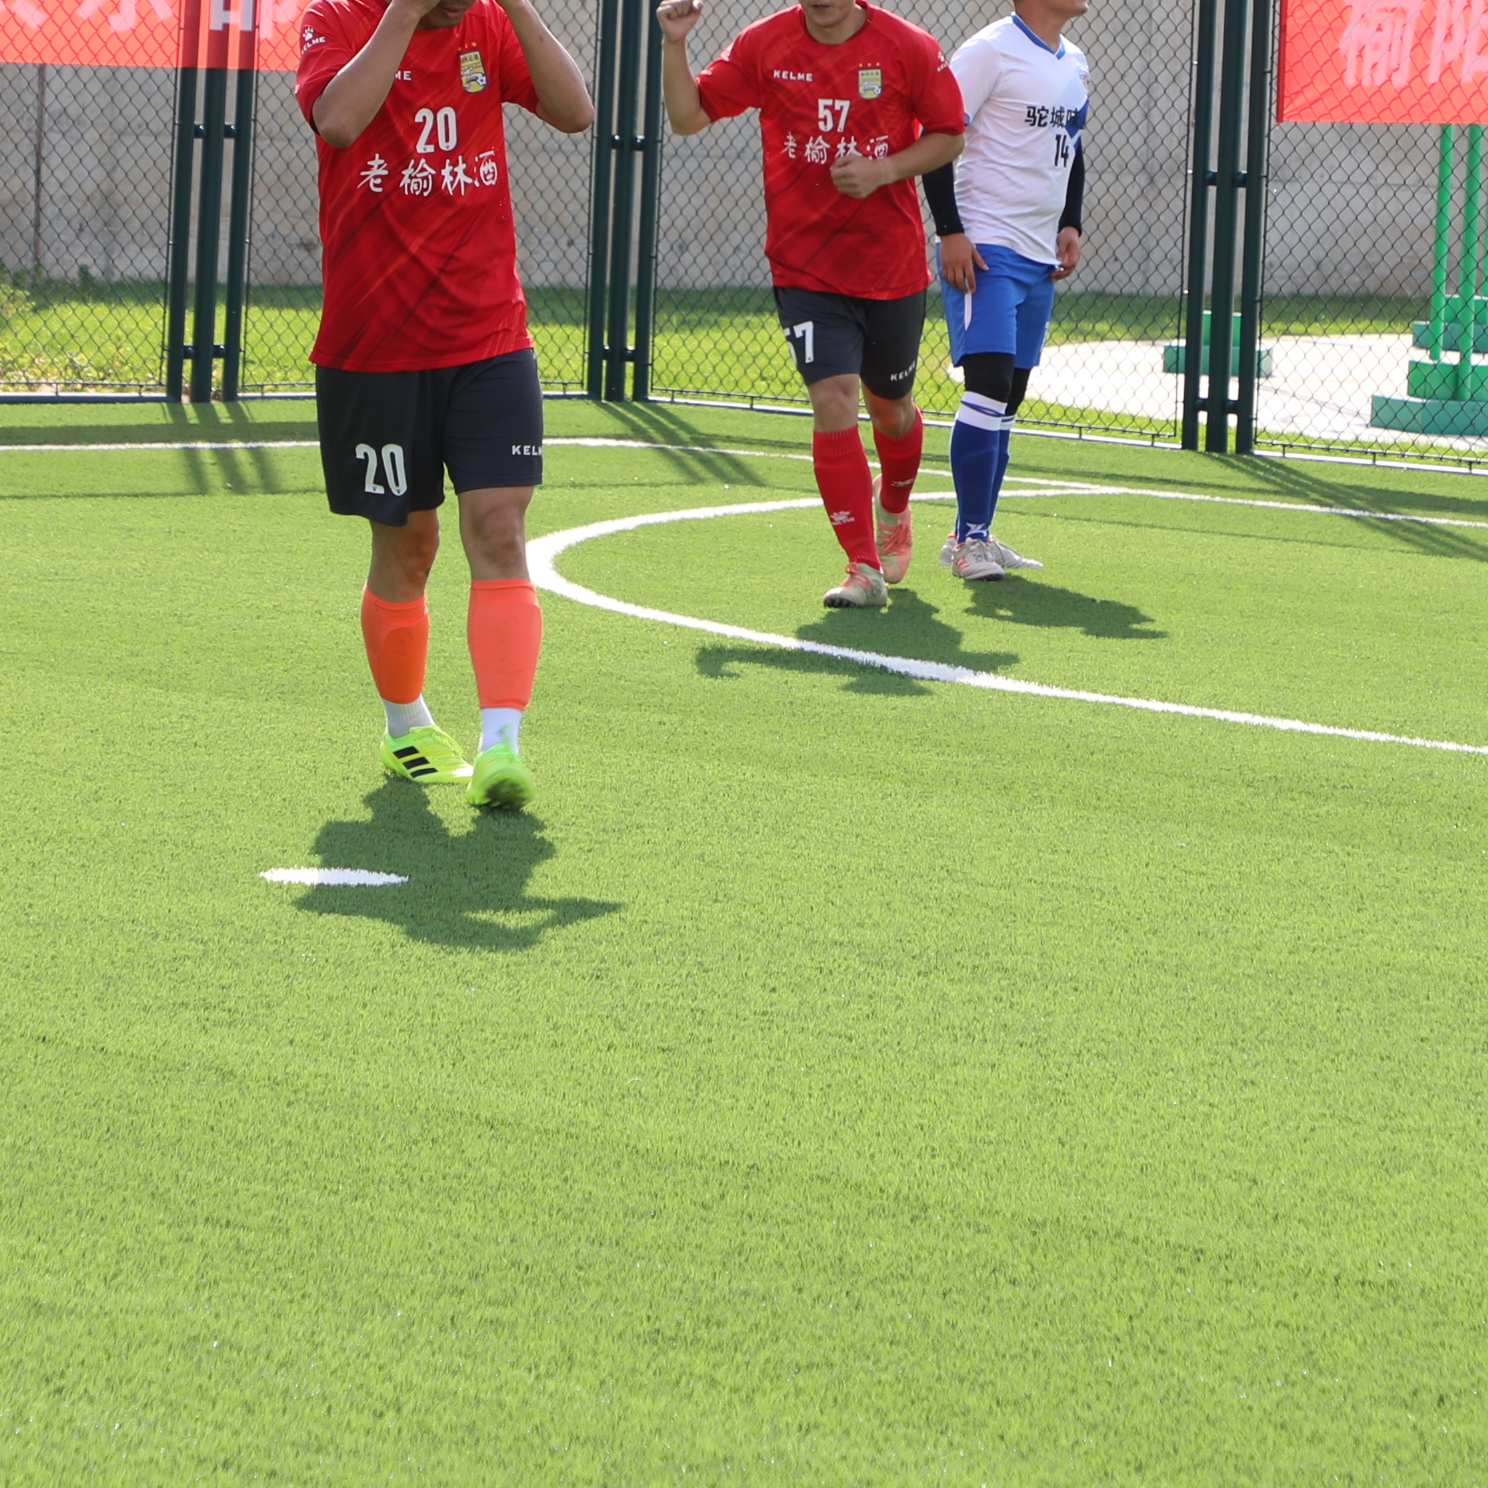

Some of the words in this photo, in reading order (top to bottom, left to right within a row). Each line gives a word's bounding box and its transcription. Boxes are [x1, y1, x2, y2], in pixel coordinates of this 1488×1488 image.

[773, 69, 814, 82] KELME
[414, 106, 458, 153] 20
[817, 98, 851, 133] 57
[780, 131, 890, 165] 老榆林酒
[1055, 133, 1069, 168] 14
[357, 152, 499, 197] 老榆林酒
[355, 443, 408, 496] 20
